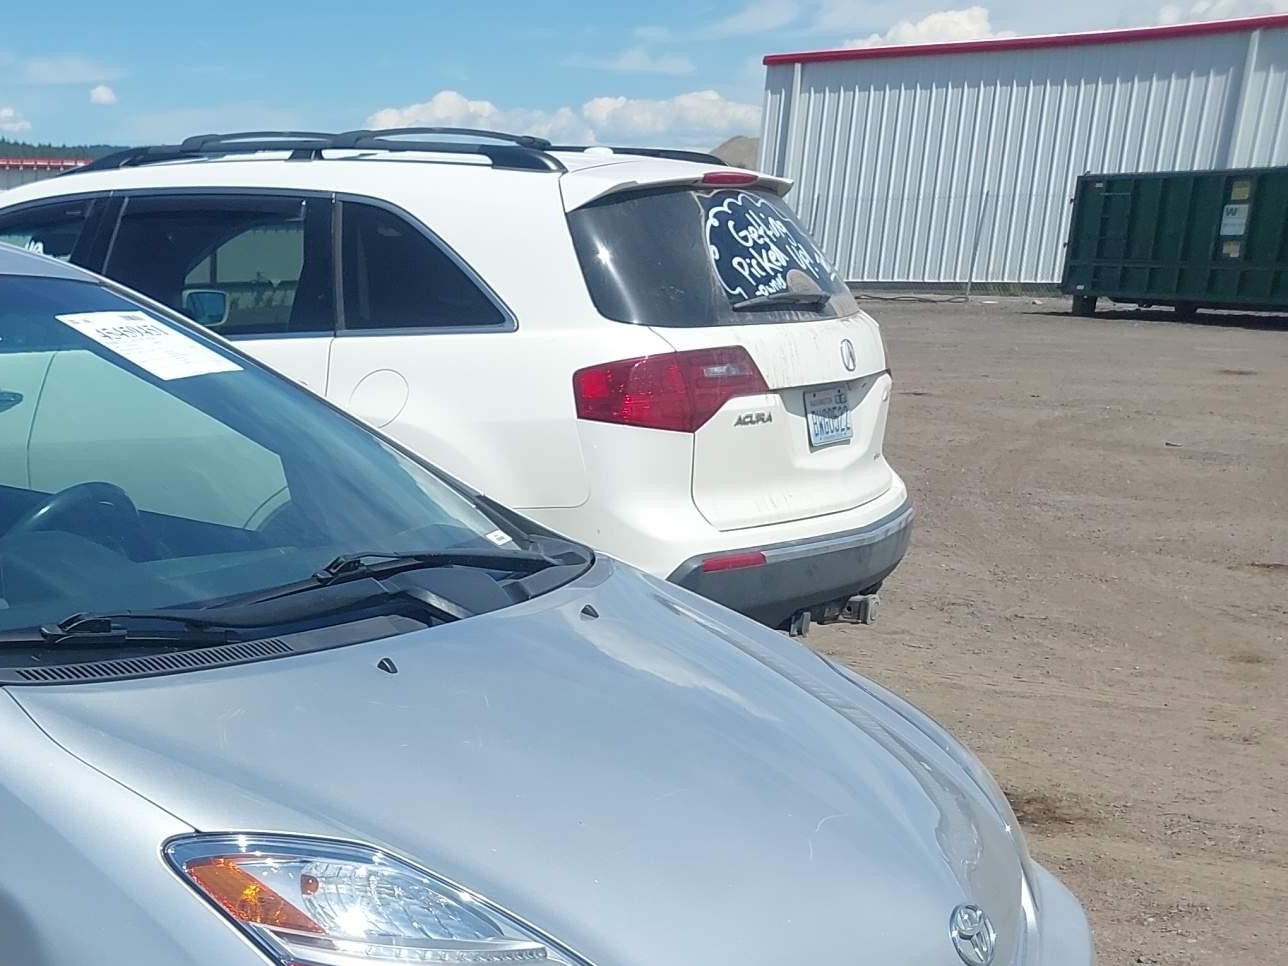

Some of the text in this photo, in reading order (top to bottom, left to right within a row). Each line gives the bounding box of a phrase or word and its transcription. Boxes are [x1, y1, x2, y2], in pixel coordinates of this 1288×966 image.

[728, 209, 797, 248] Getting
[732, 243, 789, 286] Picked
[733, 410, 773, 428] ACURA
